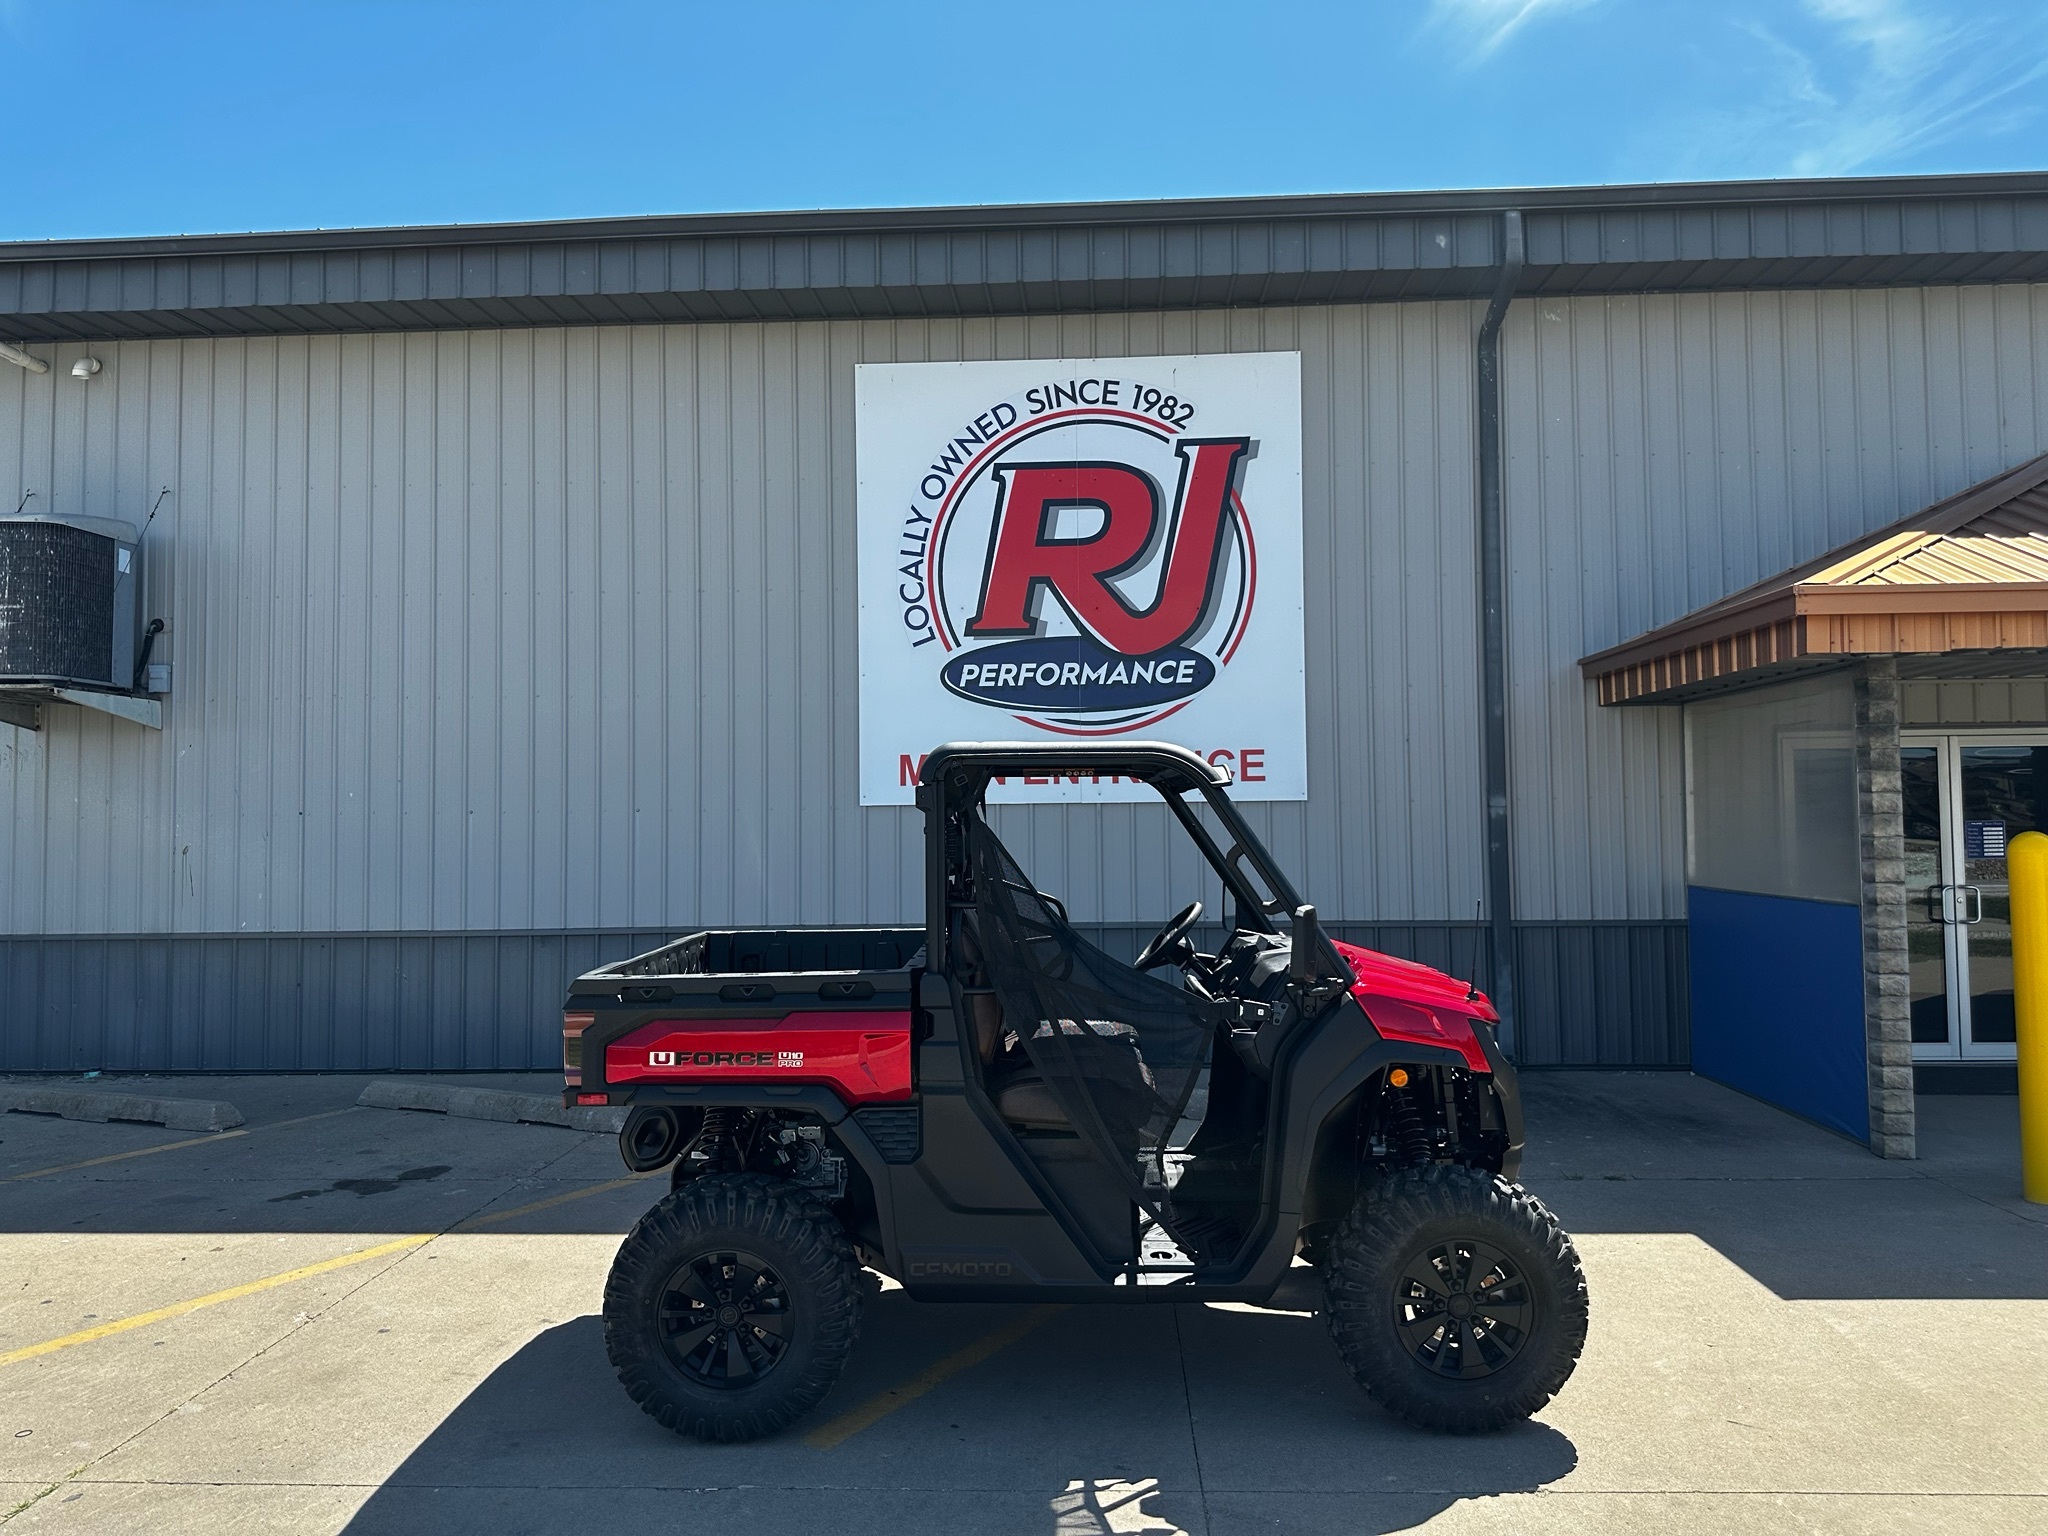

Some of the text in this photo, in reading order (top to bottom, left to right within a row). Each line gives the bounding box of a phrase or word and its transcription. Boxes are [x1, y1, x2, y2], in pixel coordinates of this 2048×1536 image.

[899, 379, 1195, 648] LOCALLY OWNED SINCE 1982
[964, 436, 1253, 660] RJ
[959, 660, 1196, 687] PERFORMANCE
[778, 1060, 804, 1068] PRO
[910, 1262, 1012, 1277] CFMOTO
